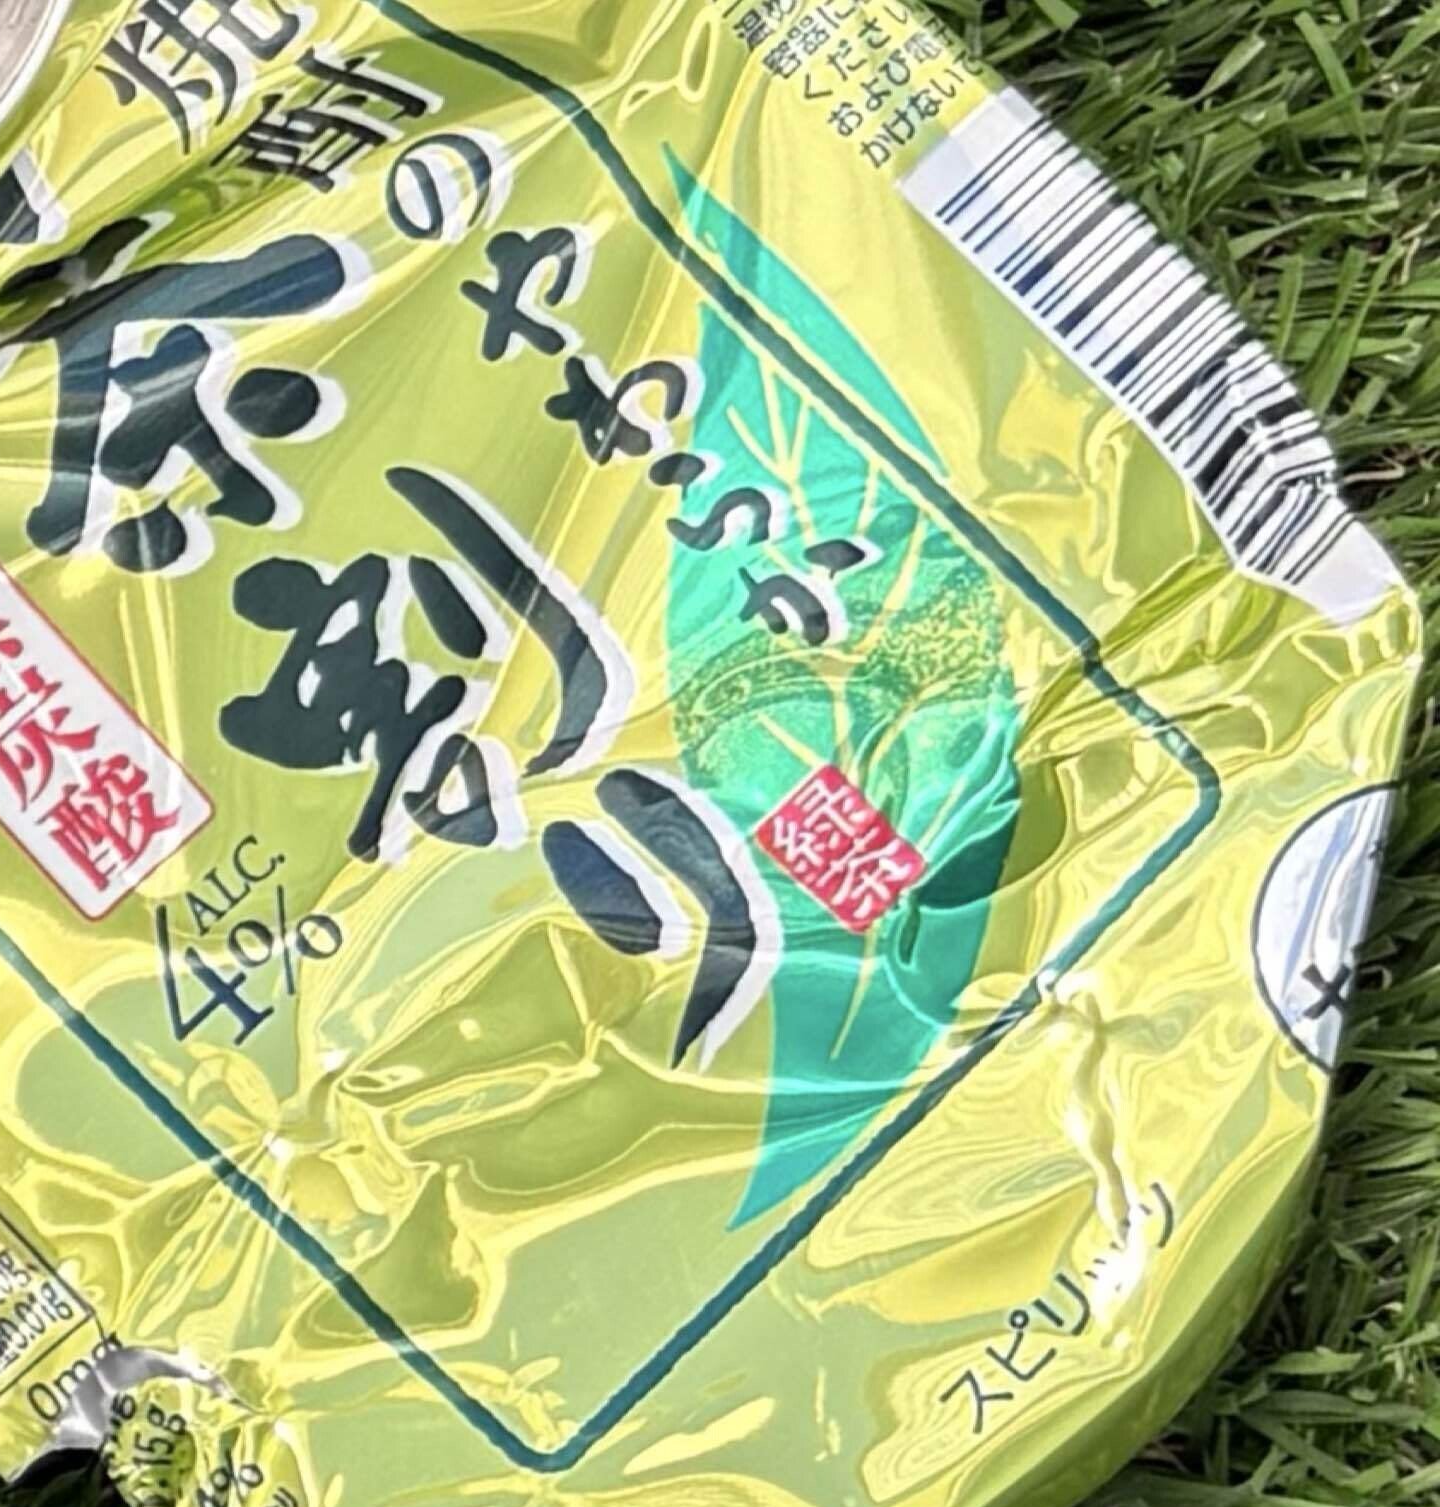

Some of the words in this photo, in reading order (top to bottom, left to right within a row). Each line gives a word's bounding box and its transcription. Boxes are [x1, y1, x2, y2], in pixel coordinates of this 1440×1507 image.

[180, 830, 289, 938] ALC.
[765, 775, 916, 928] 緑茶
[157, 882, 346, 1047] 4%
